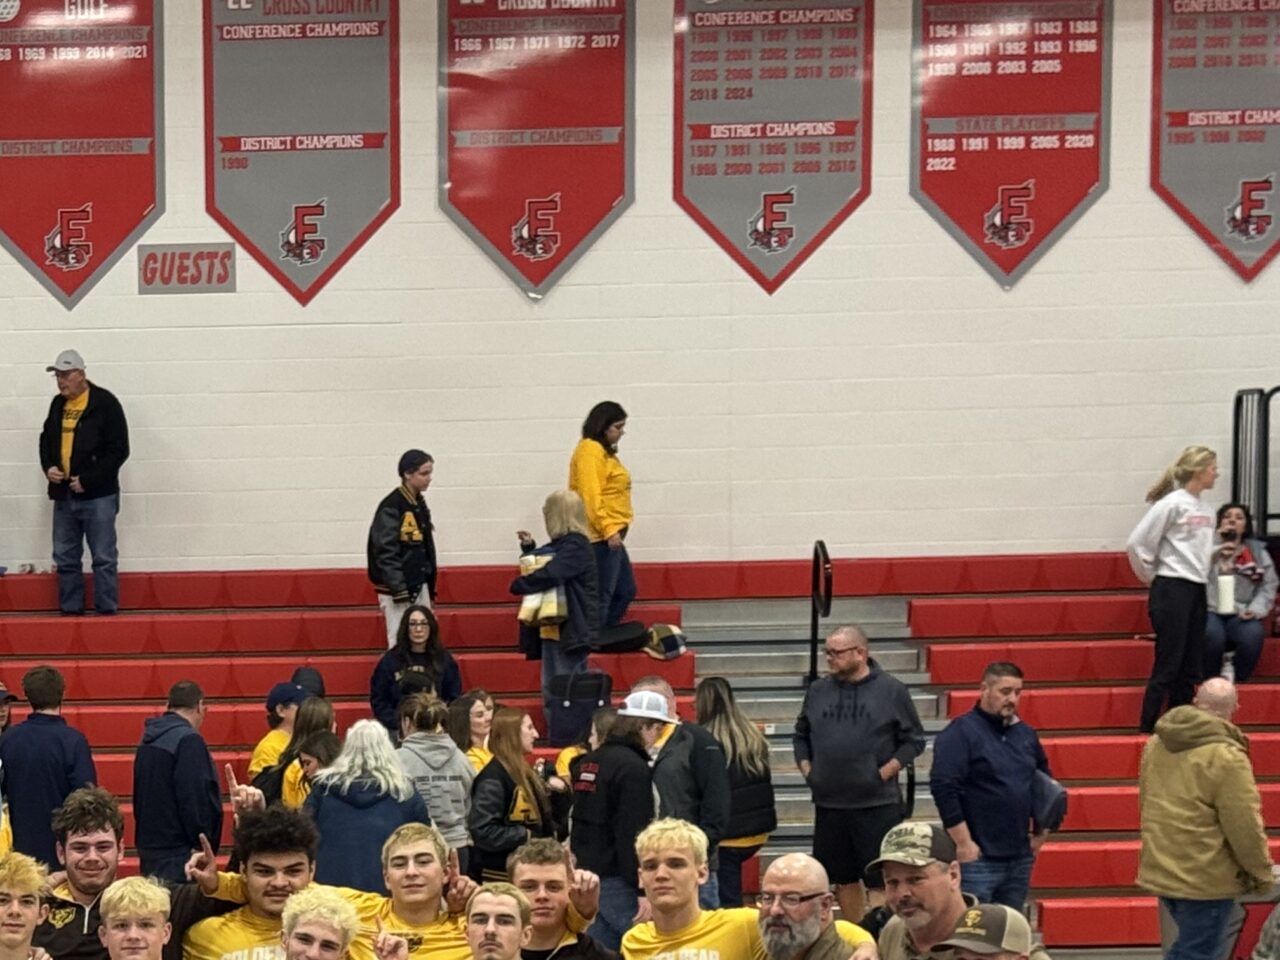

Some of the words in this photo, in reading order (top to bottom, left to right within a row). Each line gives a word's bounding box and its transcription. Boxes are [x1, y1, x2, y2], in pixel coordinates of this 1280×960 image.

[695, 12, 776, 26] CONFERENCE
[779, 9, 854, 24] CHAMPIONS
[223, 24, 303, 39] CONFERENCE
[306, 22, 379, 37] CHAMPIONS
[591, 35, 620, 48] 2017
[1188, 111, 1242, 126] DISTRICT
[470, 132, 525, 145] DISTRICT
[530, 130, 603, 143] CHAMPIONS
[710, 124, 762, 138] DISTRICT
[765, 122, 835, 136] CHAMPIONS
[1, 141, 56, 155] DISTRICT
[61, 140, 134, 154] CHAMPIONS
[240, 137, 293, 150] DISTRICT
[295, 134, 364, 149] CHAMPIONS
[142, 250, 232, 286] GUESTS
[401, 512, 424, 542] A
